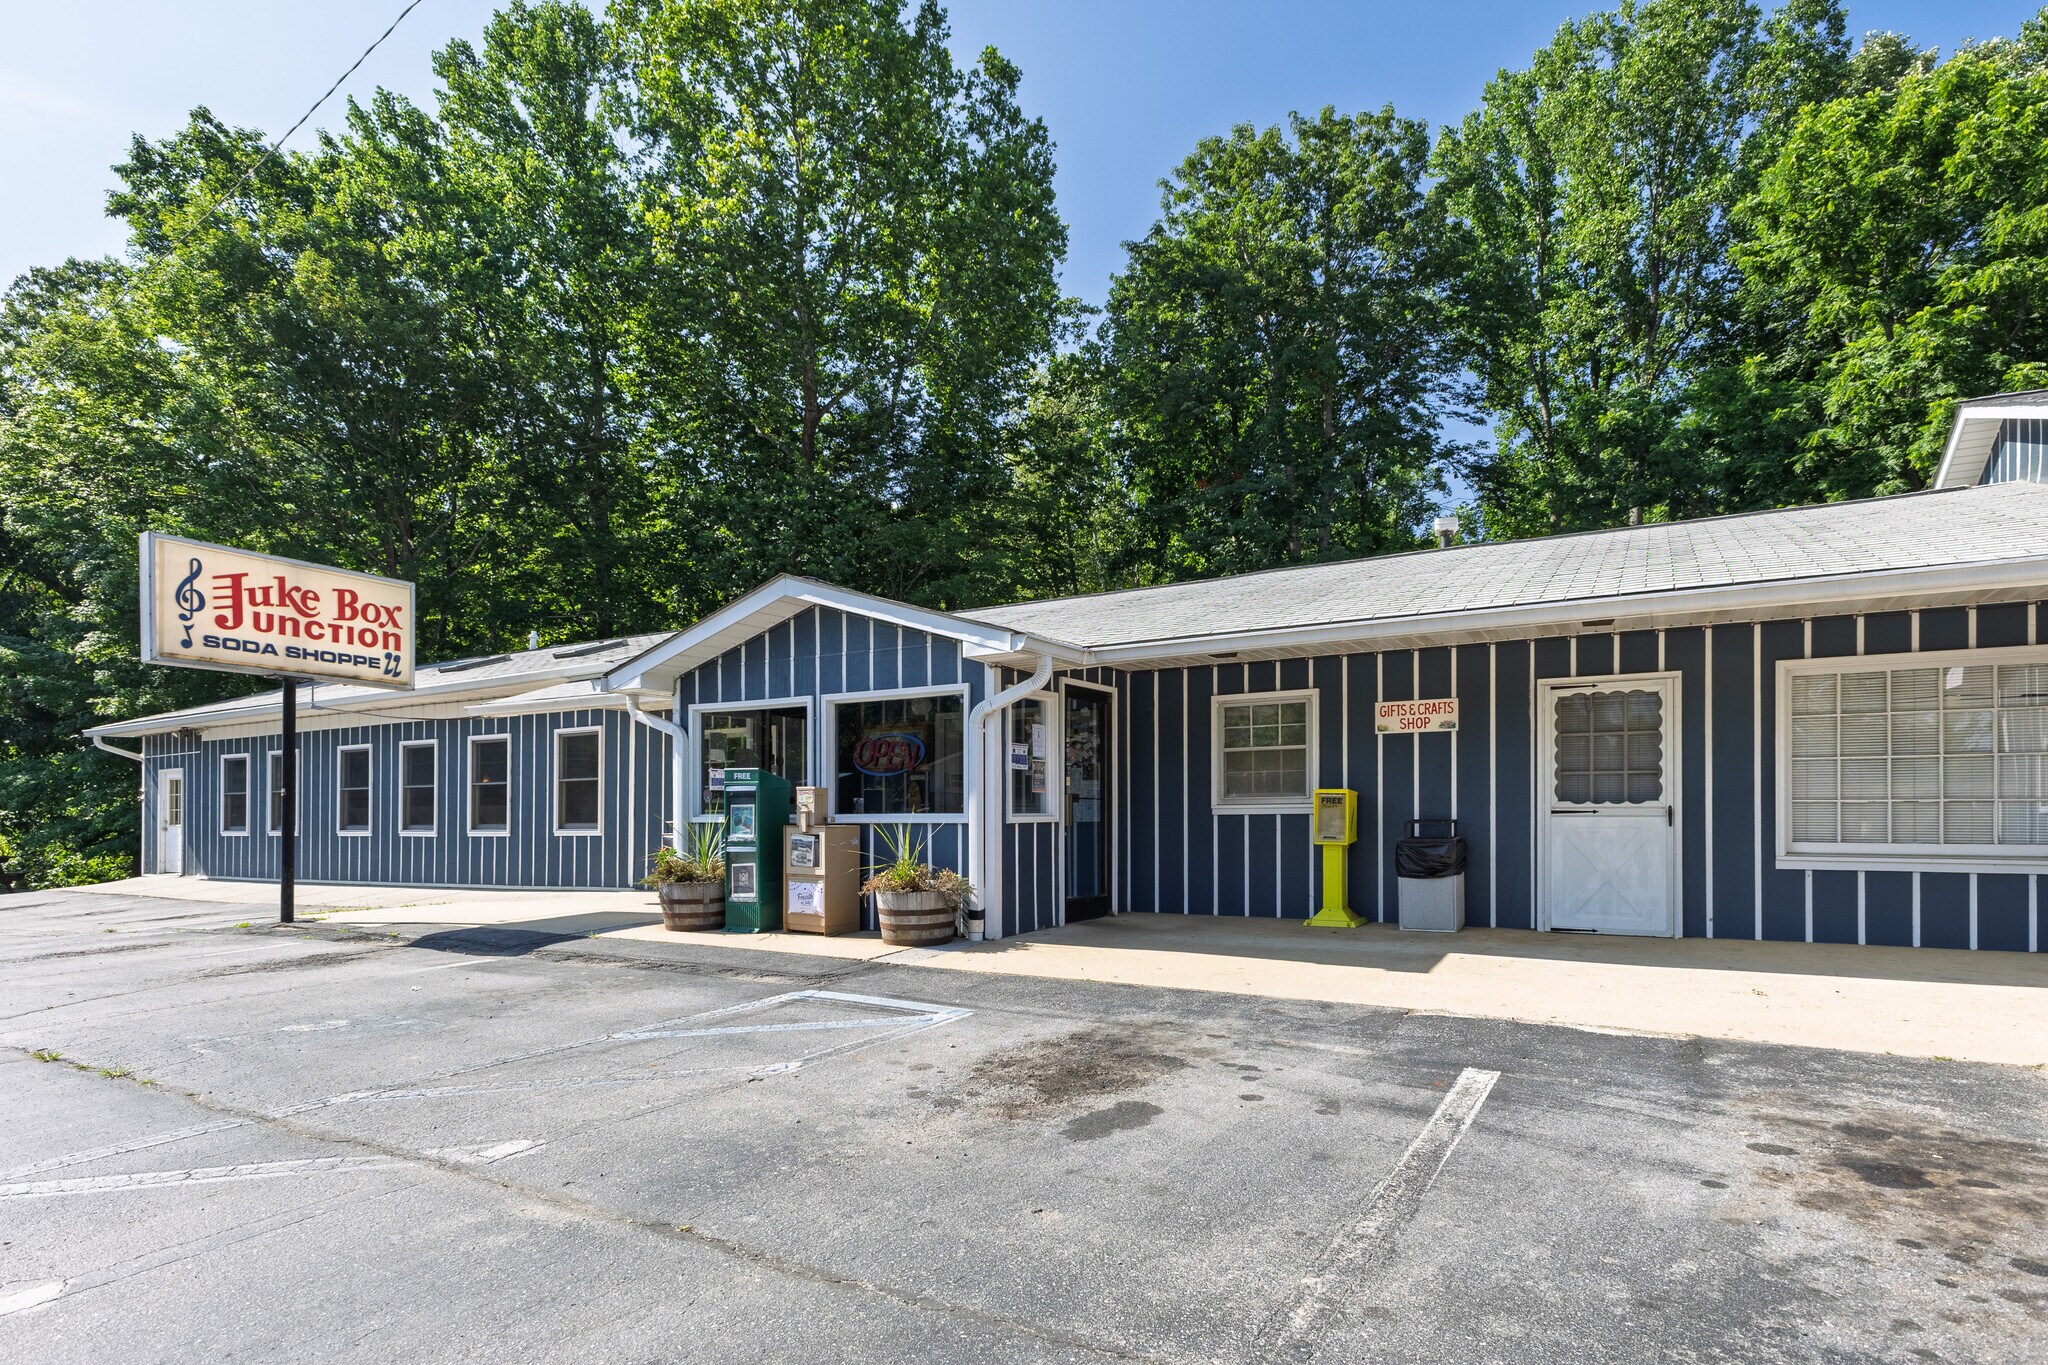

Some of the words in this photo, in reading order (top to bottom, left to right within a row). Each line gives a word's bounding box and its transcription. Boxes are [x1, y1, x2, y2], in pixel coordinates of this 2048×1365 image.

[212, 572, 321, 630] Juke
[332, 588, 403, 630] Box
[203, 634, 279, 656] SODA
[285, 646, 381, 669] SHOPPE
[1380, 704, 1407, 718] GIFTS
[1409, 703, 1416, 716] &
[1417, 701, 1454, 716] CRAFTS
[1400, 716, 1431, 730] SHOP
[854, 736, 919, 772] OPEN
[733, 772, 751, 780] FREE
[1321, 797, 1343, 805] FREE
